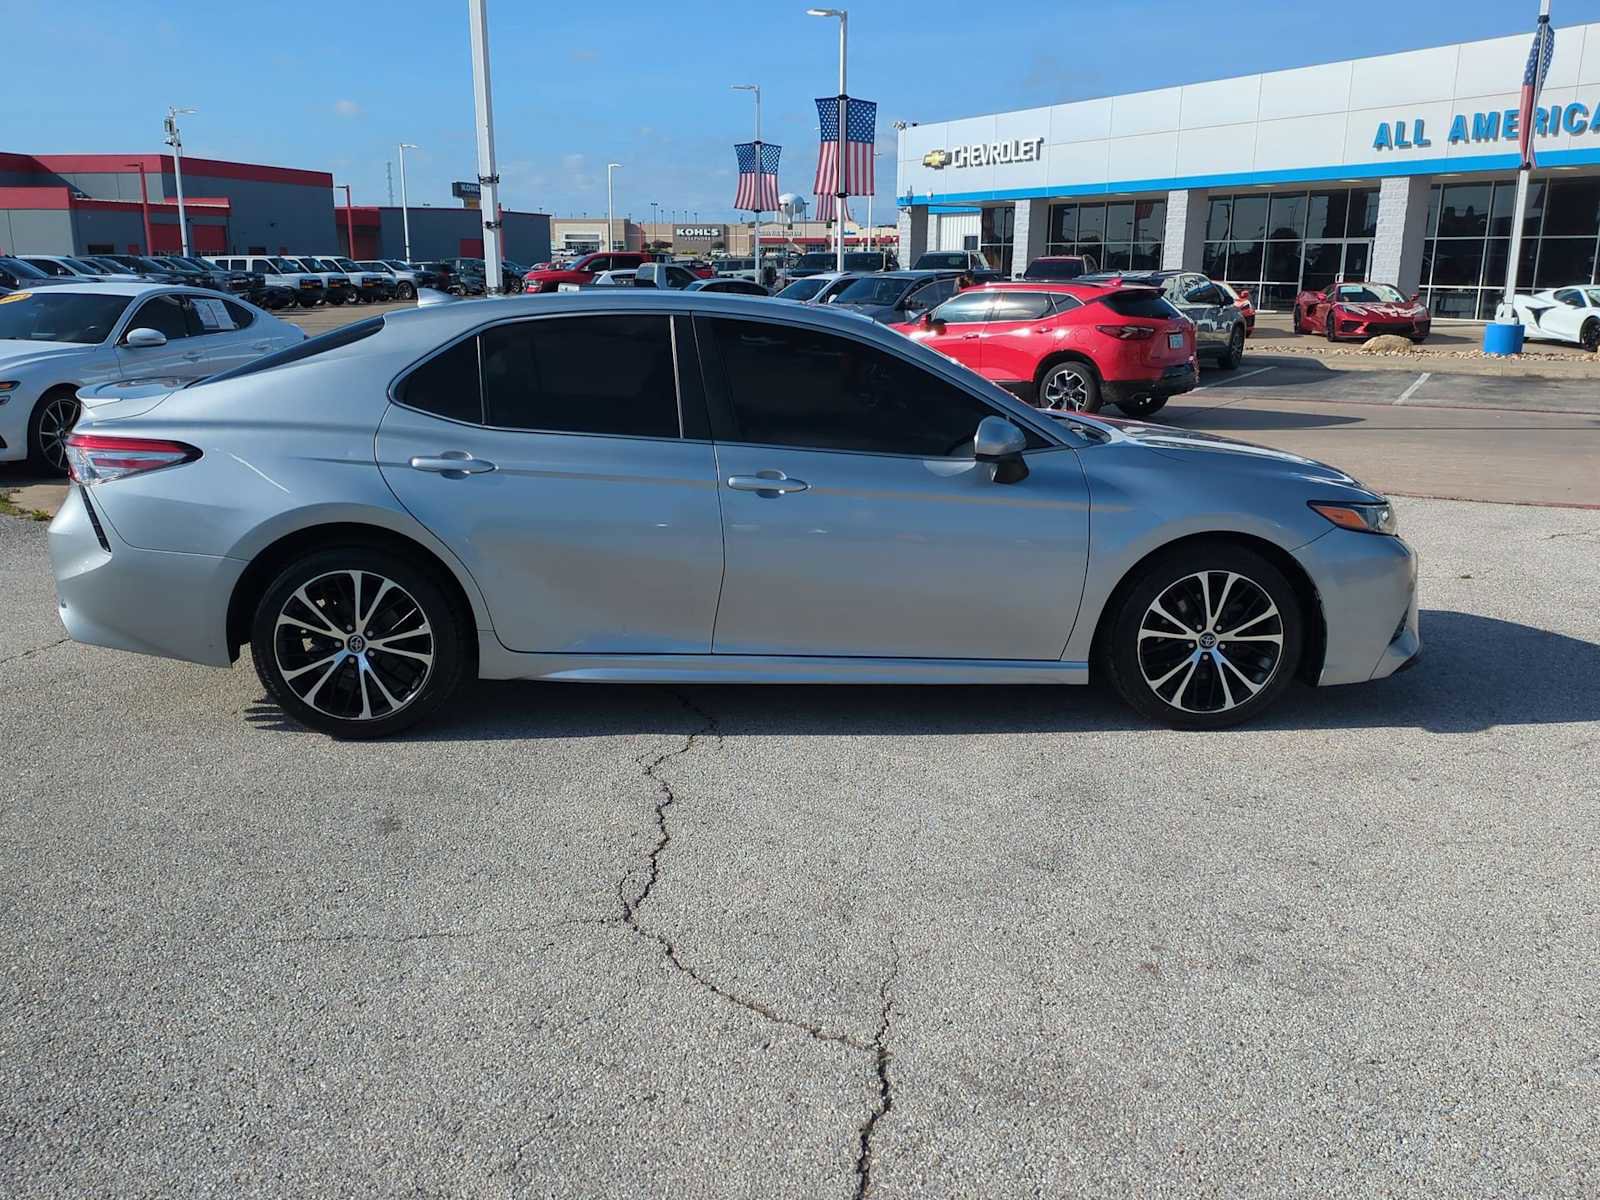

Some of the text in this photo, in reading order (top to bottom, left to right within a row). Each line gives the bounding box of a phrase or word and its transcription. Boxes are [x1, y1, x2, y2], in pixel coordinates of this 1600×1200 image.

[1372, 118, 1431, 151] ALL
[951, 137, 1045, 169] CHEVROLET
[676, 228, 720, 237] KOHL'S
